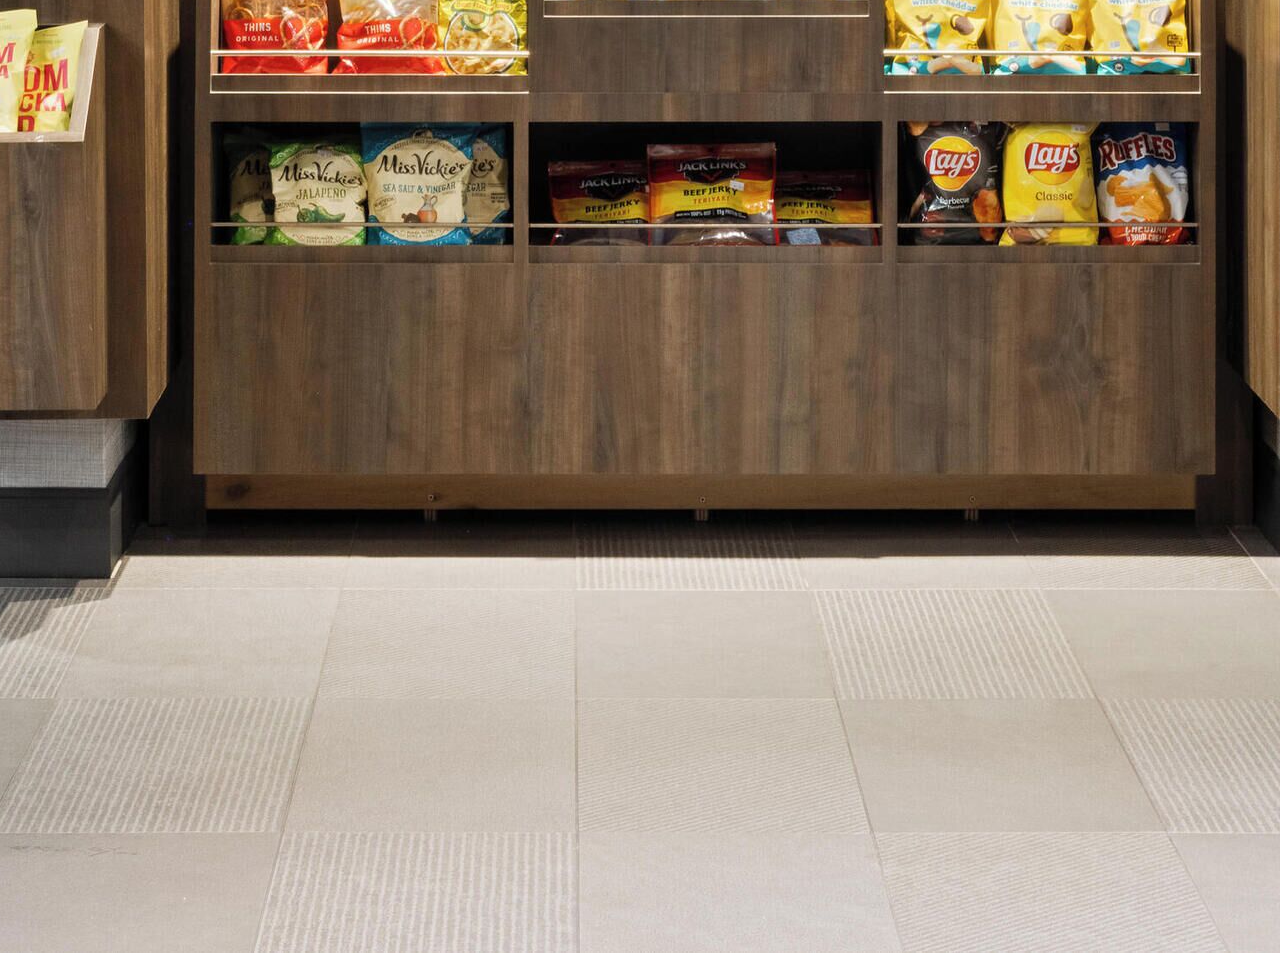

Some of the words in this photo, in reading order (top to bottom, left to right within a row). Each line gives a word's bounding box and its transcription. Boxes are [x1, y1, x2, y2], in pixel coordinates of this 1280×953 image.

[243, 23, 272, 33] THINS
[364, 23, 391, 34] THINS
[235, 34, 280, 43] ORIGINAL
[1028, 142, 1080, 174] Lay's
[1098, 132, 1177, 172] RUFFLES
[377, 154, 416, 176] Miss
[412, 150, 465, 181] Vickie's
[677, 162, 708, 172] JACK
[928, 148, 978, 177] Lay's
[278, 163, 315, 182] Miss
[312, 160, 363, 188] Vickie's
[383, 183, 396, 193] SEA
[398, 184, 416, 193] SALT
[425, 181, 456, 194] VINEGAR
[683, 187, 706, 197] BEEF
[708, 185, 739, 196] JERKY
[1034, 190, 1074, 202] Classic
